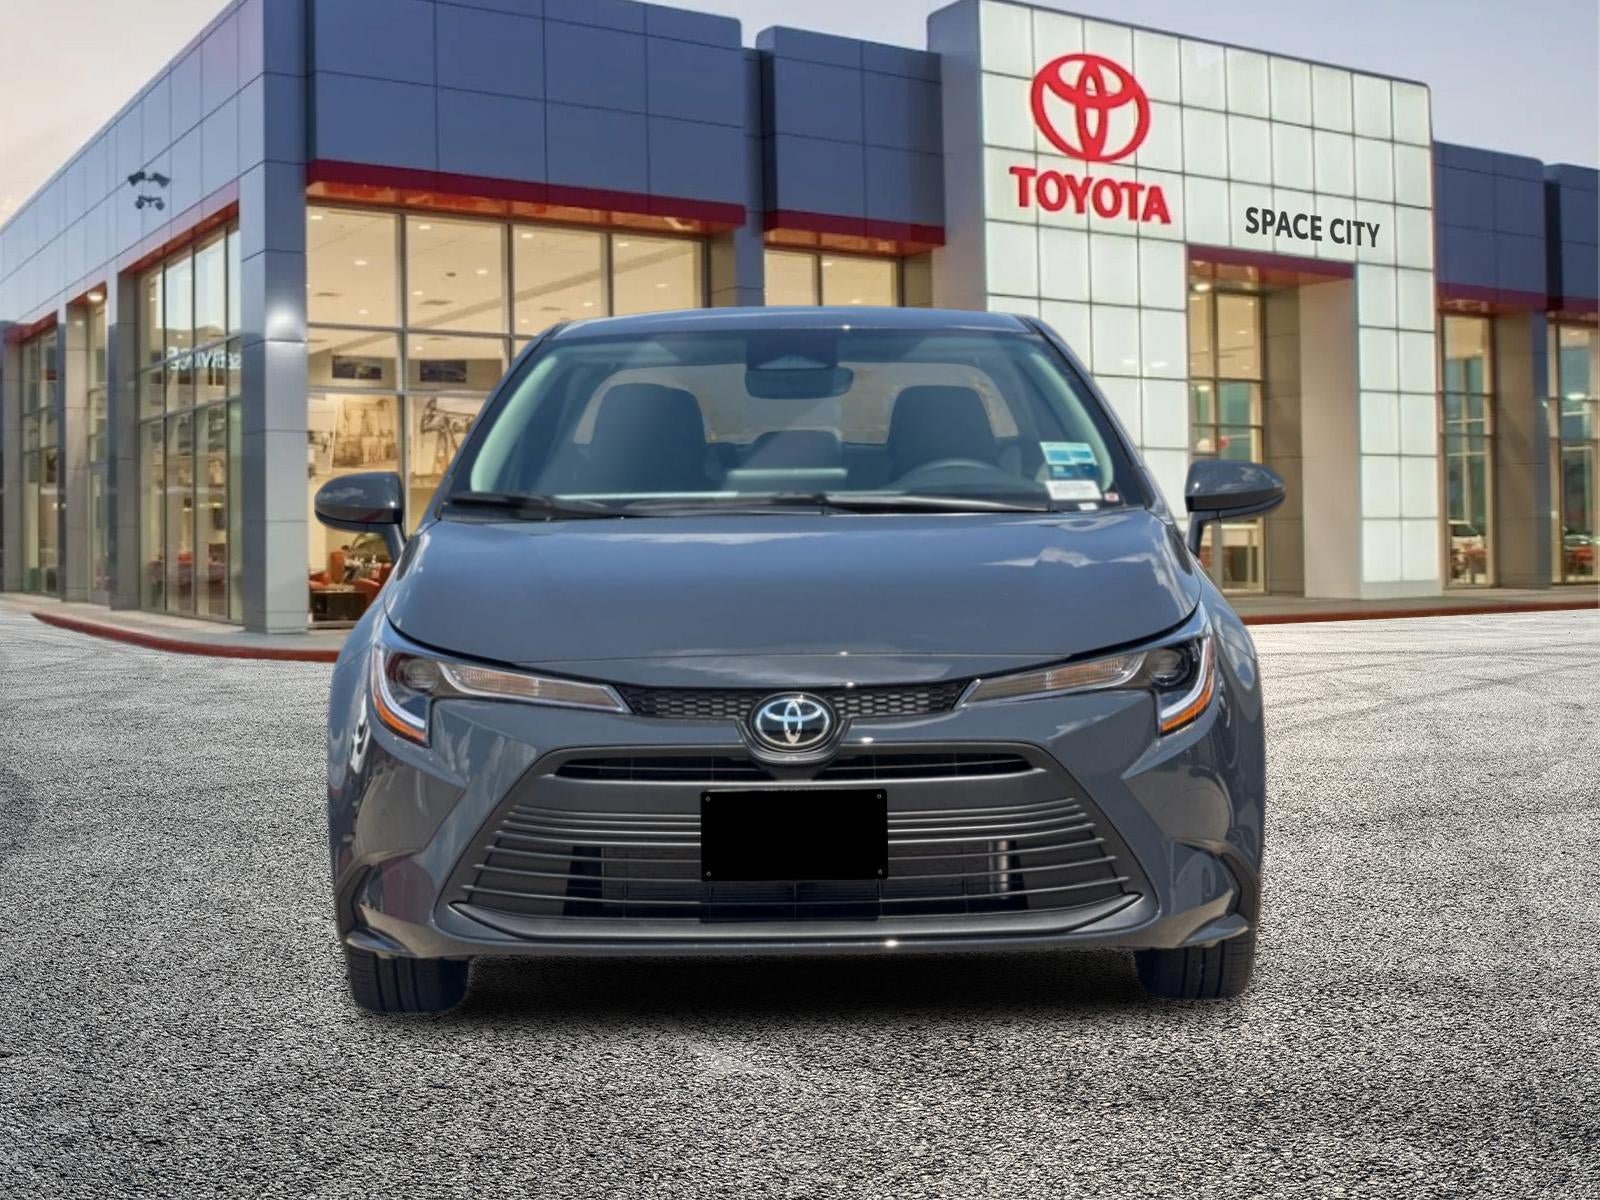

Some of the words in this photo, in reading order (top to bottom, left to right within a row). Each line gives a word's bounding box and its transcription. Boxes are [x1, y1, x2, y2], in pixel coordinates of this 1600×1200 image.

[1009, 166, 1171, 225] TOYOTA
[1245, 206, 1323, 242] SPACE
[1329, 218, 1381, 248] CITY
